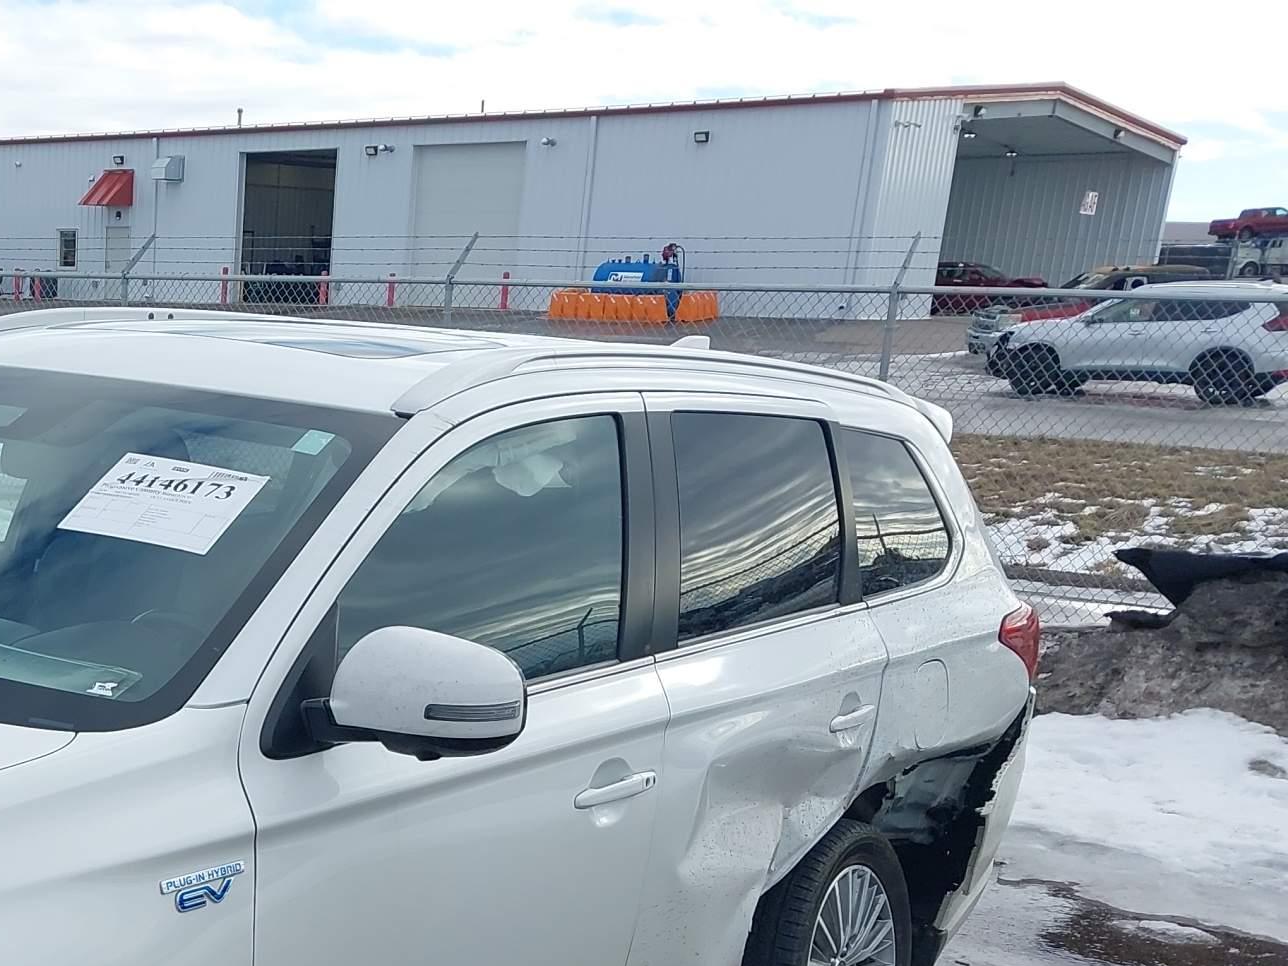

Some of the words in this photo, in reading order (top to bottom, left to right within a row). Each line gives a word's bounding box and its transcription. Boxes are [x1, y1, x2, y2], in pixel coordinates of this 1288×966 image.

[117, 471, 236, 500] 44146173
[165, 873, 205, 891] PLUG-IN
[207, 862, 242, 880] HYBRID
[175, 877, 233, 913] EV
